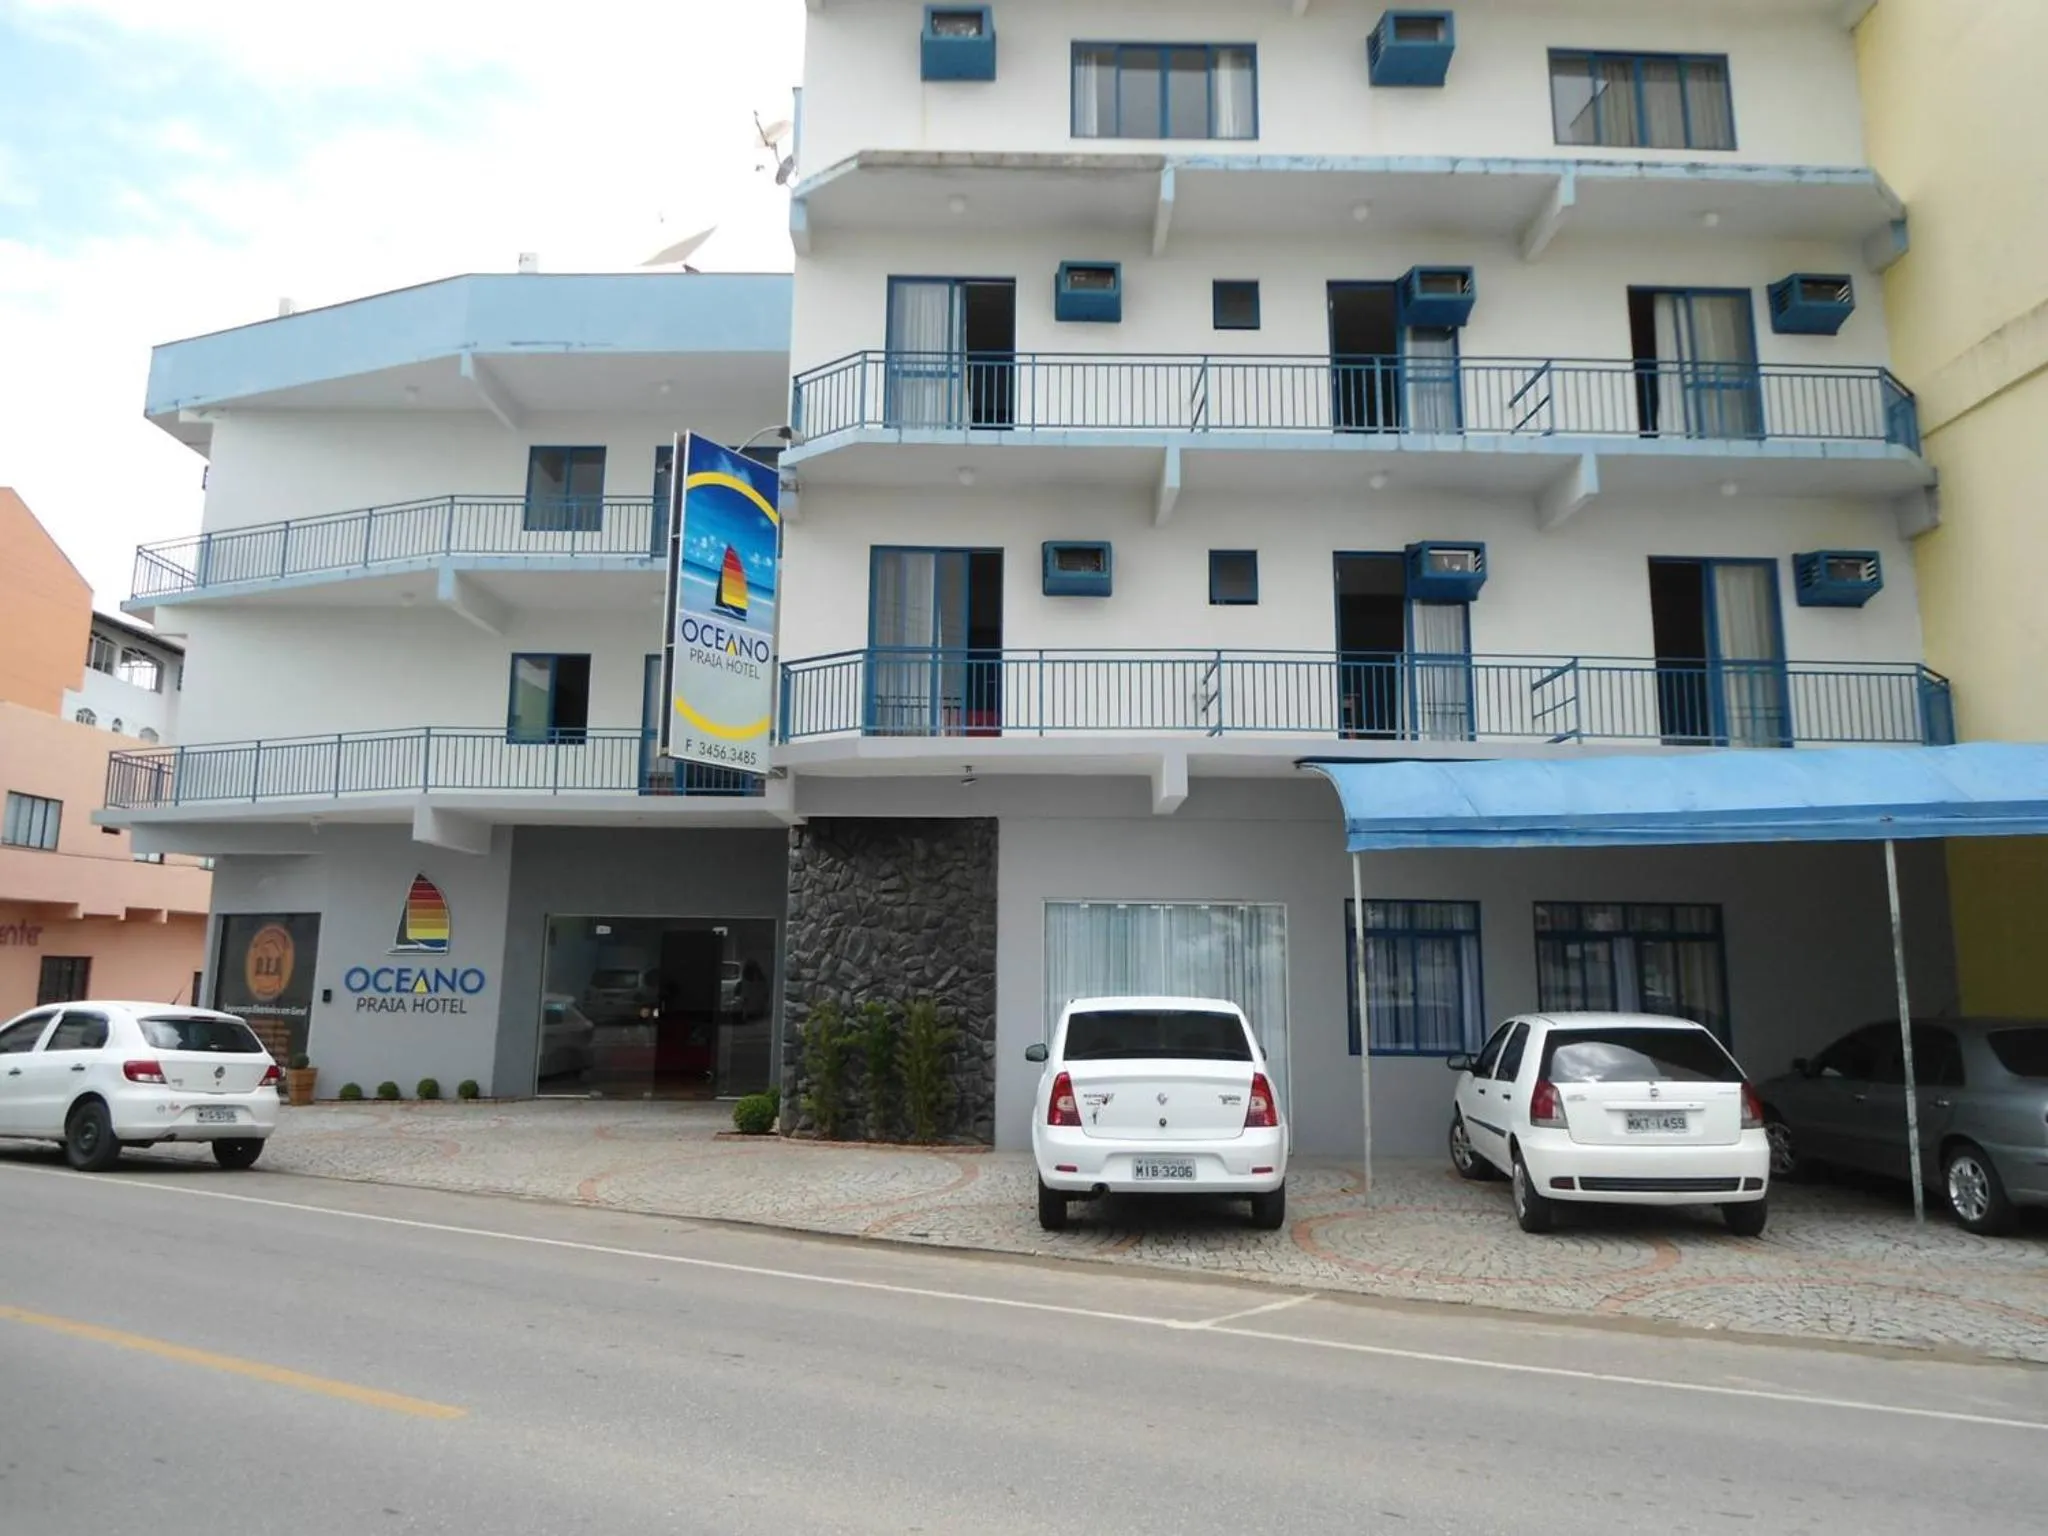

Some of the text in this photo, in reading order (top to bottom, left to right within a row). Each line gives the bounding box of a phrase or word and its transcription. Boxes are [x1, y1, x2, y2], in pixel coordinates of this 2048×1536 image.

[682, 618, 769, 663] OCEANO
[690, 648, 760, 680] PRAIA HOTEL
[699, 741, 757, 766] 3456.3485
[344, 966, 486, 995] OCEANO
[356, 998, 467, 1014] PRAIA HOTEL
